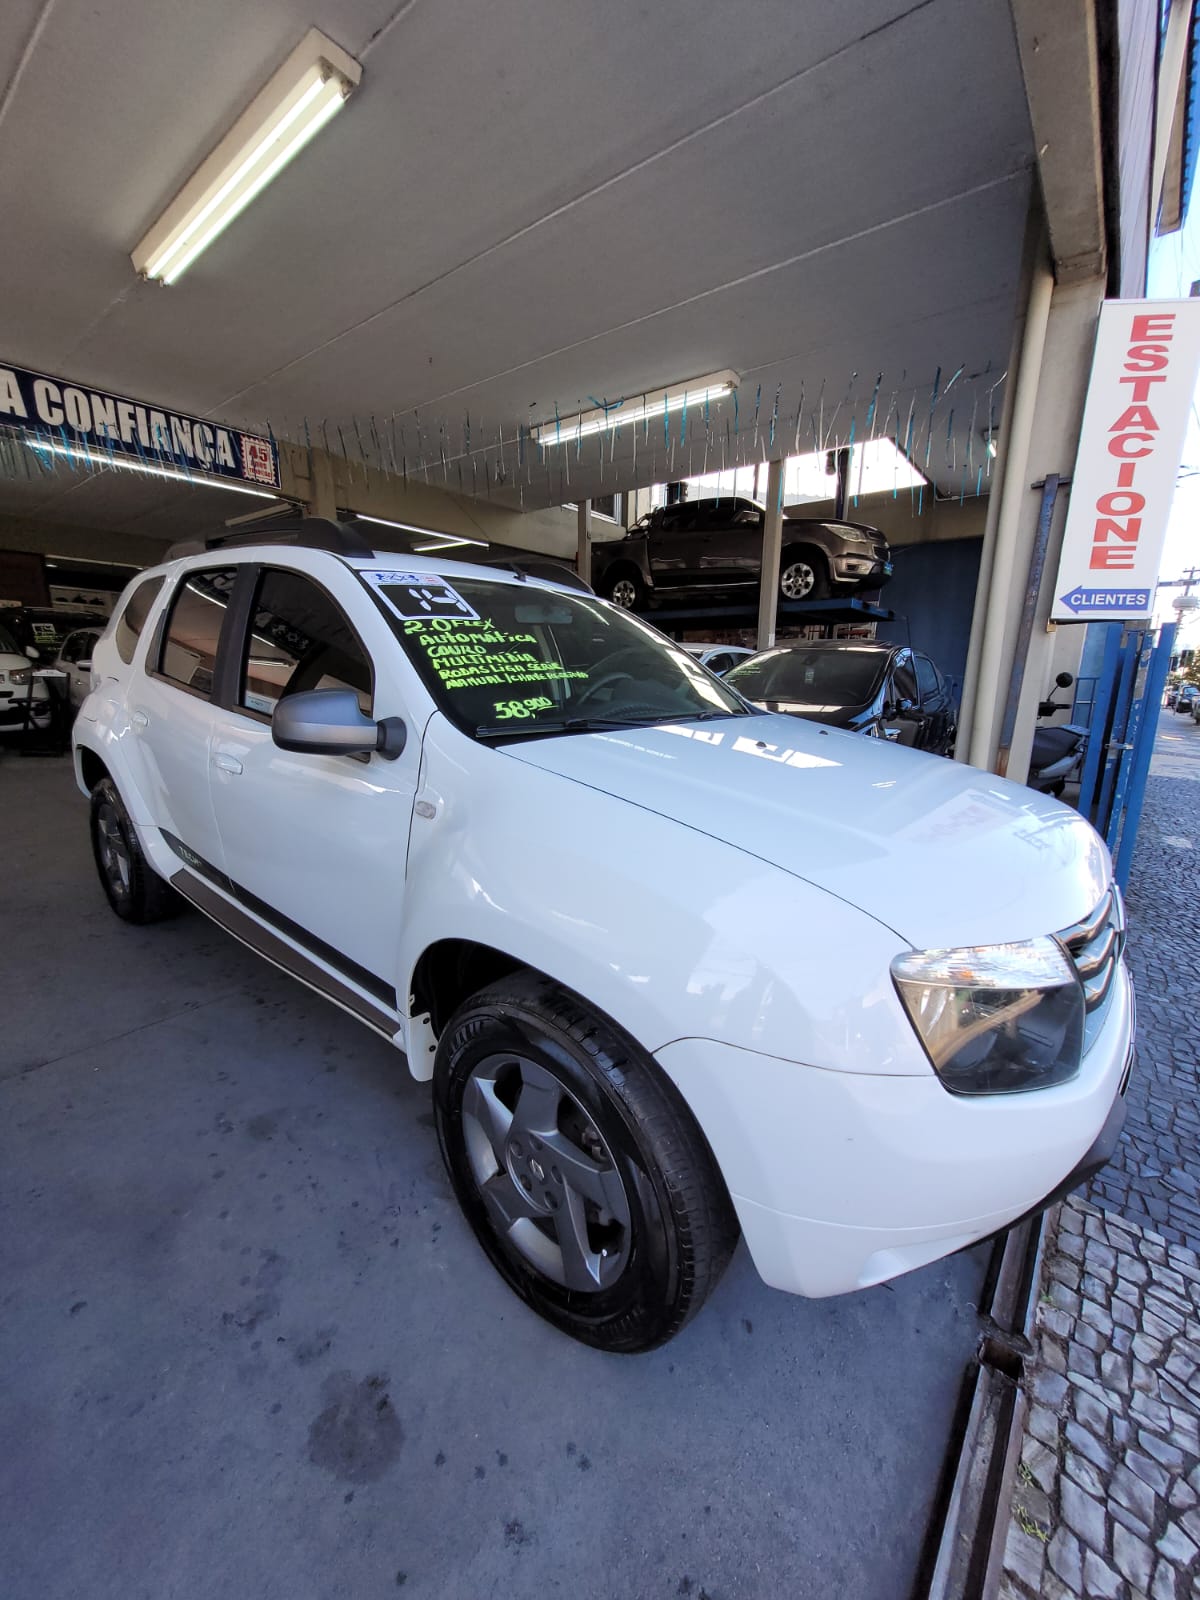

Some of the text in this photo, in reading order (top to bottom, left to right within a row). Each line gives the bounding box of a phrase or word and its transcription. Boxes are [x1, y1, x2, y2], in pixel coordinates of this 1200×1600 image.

[33, 379, 236, 470] CONFIANÇA
[1089, 314, 1176, 569] ESTACIONE
[1070, 593, 1146, 606] CLIENTES
[404, 618, 496, 635] 2.0 FLEX
[427, 645, 487, 658] COURO
[438, 666, 490, 680] RODAS
[445, 674, 505, 690] MANUAL
